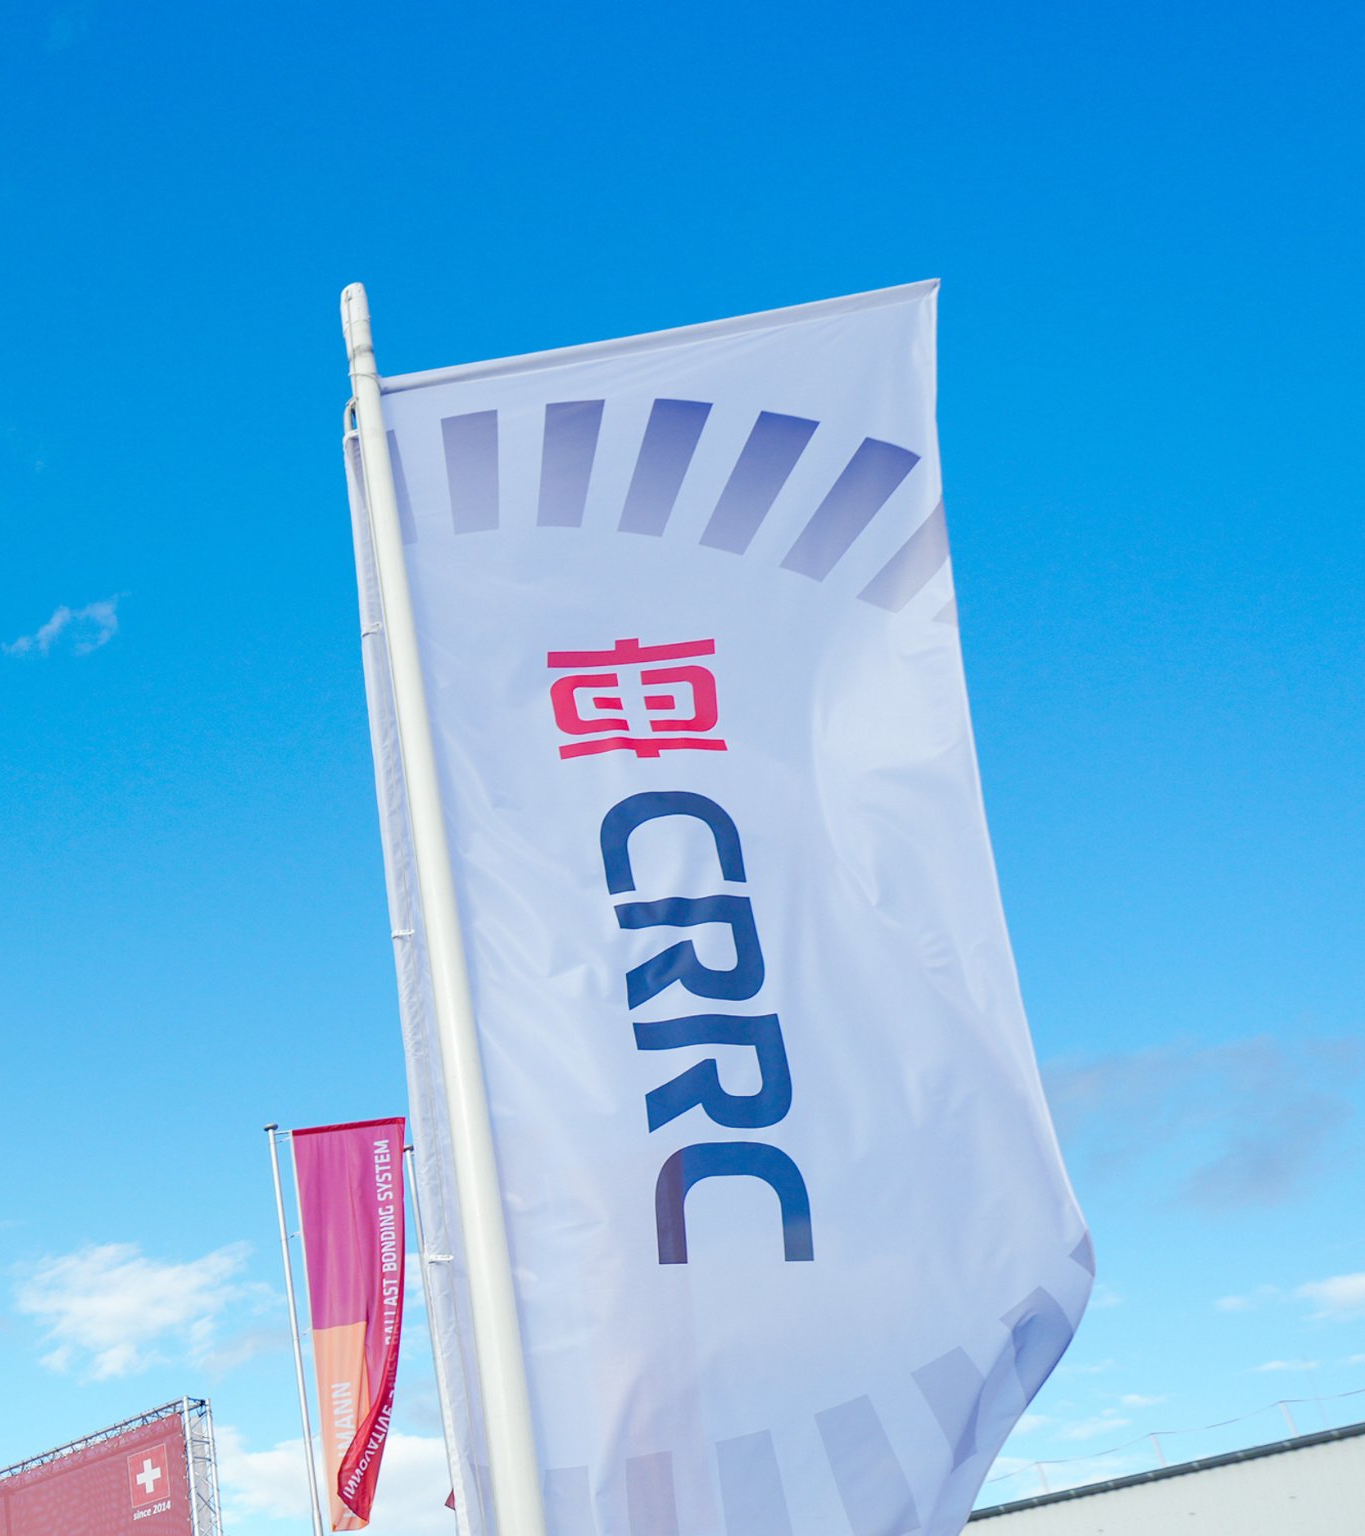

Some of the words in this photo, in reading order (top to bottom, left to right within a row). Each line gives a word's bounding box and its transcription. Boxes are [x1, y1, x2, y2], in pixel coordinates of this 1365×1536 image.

[599, 790, 815, 1264] CRRC
[373, 1139, 393, 1201] SYSTEM
[378, 1205, 397, 1273] BONDING
[133, 1508, 152, 1521] since
[153, 1500, 171, 1515] 2014
